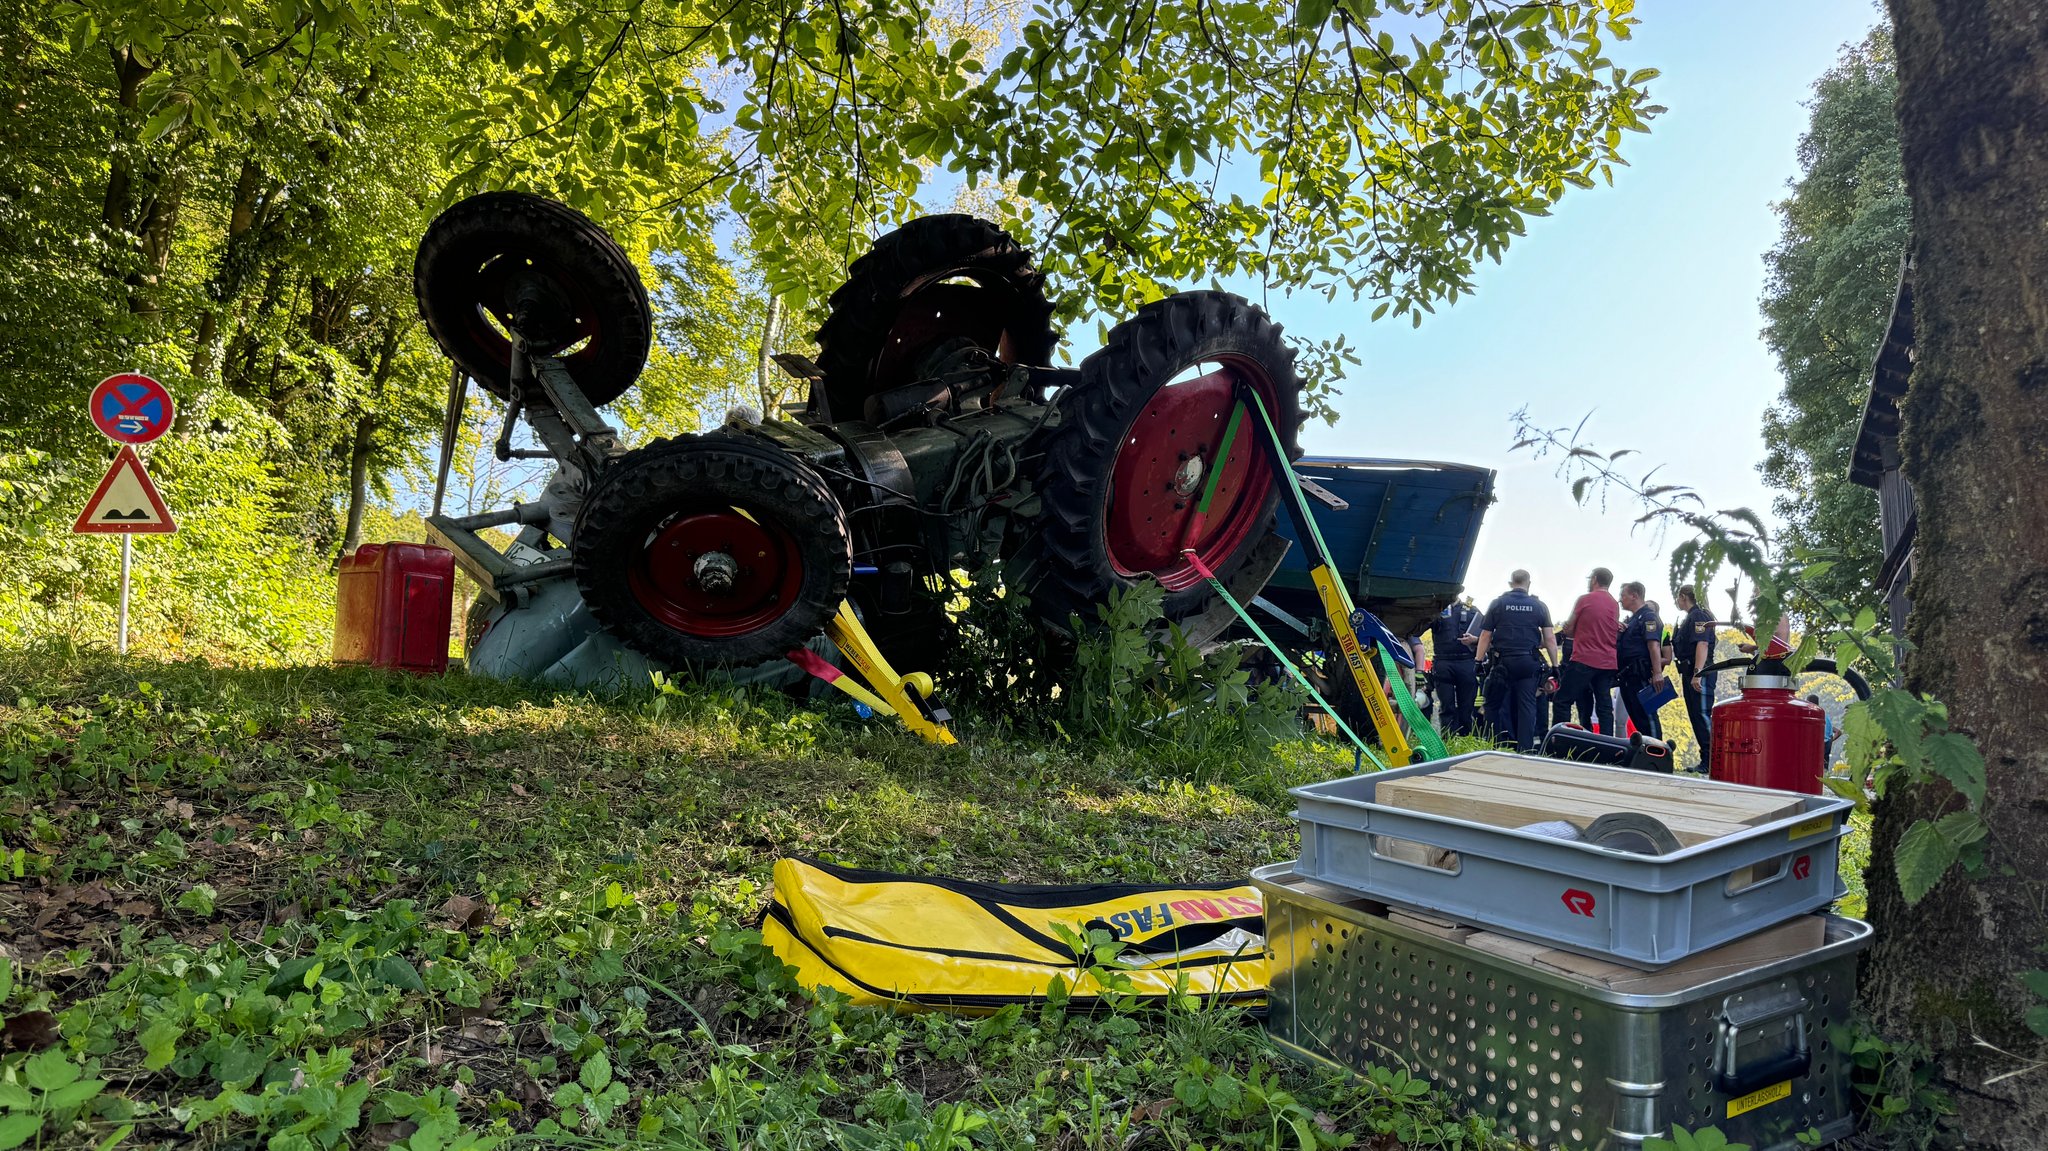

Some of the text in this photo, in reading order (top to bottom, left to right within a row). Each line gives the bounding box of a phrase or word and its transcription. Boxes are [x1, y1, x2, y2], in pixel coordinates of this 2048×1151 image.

[1505, 604, 1533, 612] POLIZEI
[1342, 634, 1363, 670] STAB FAST
[1095, 896, 1263, 938] STAB FAS
